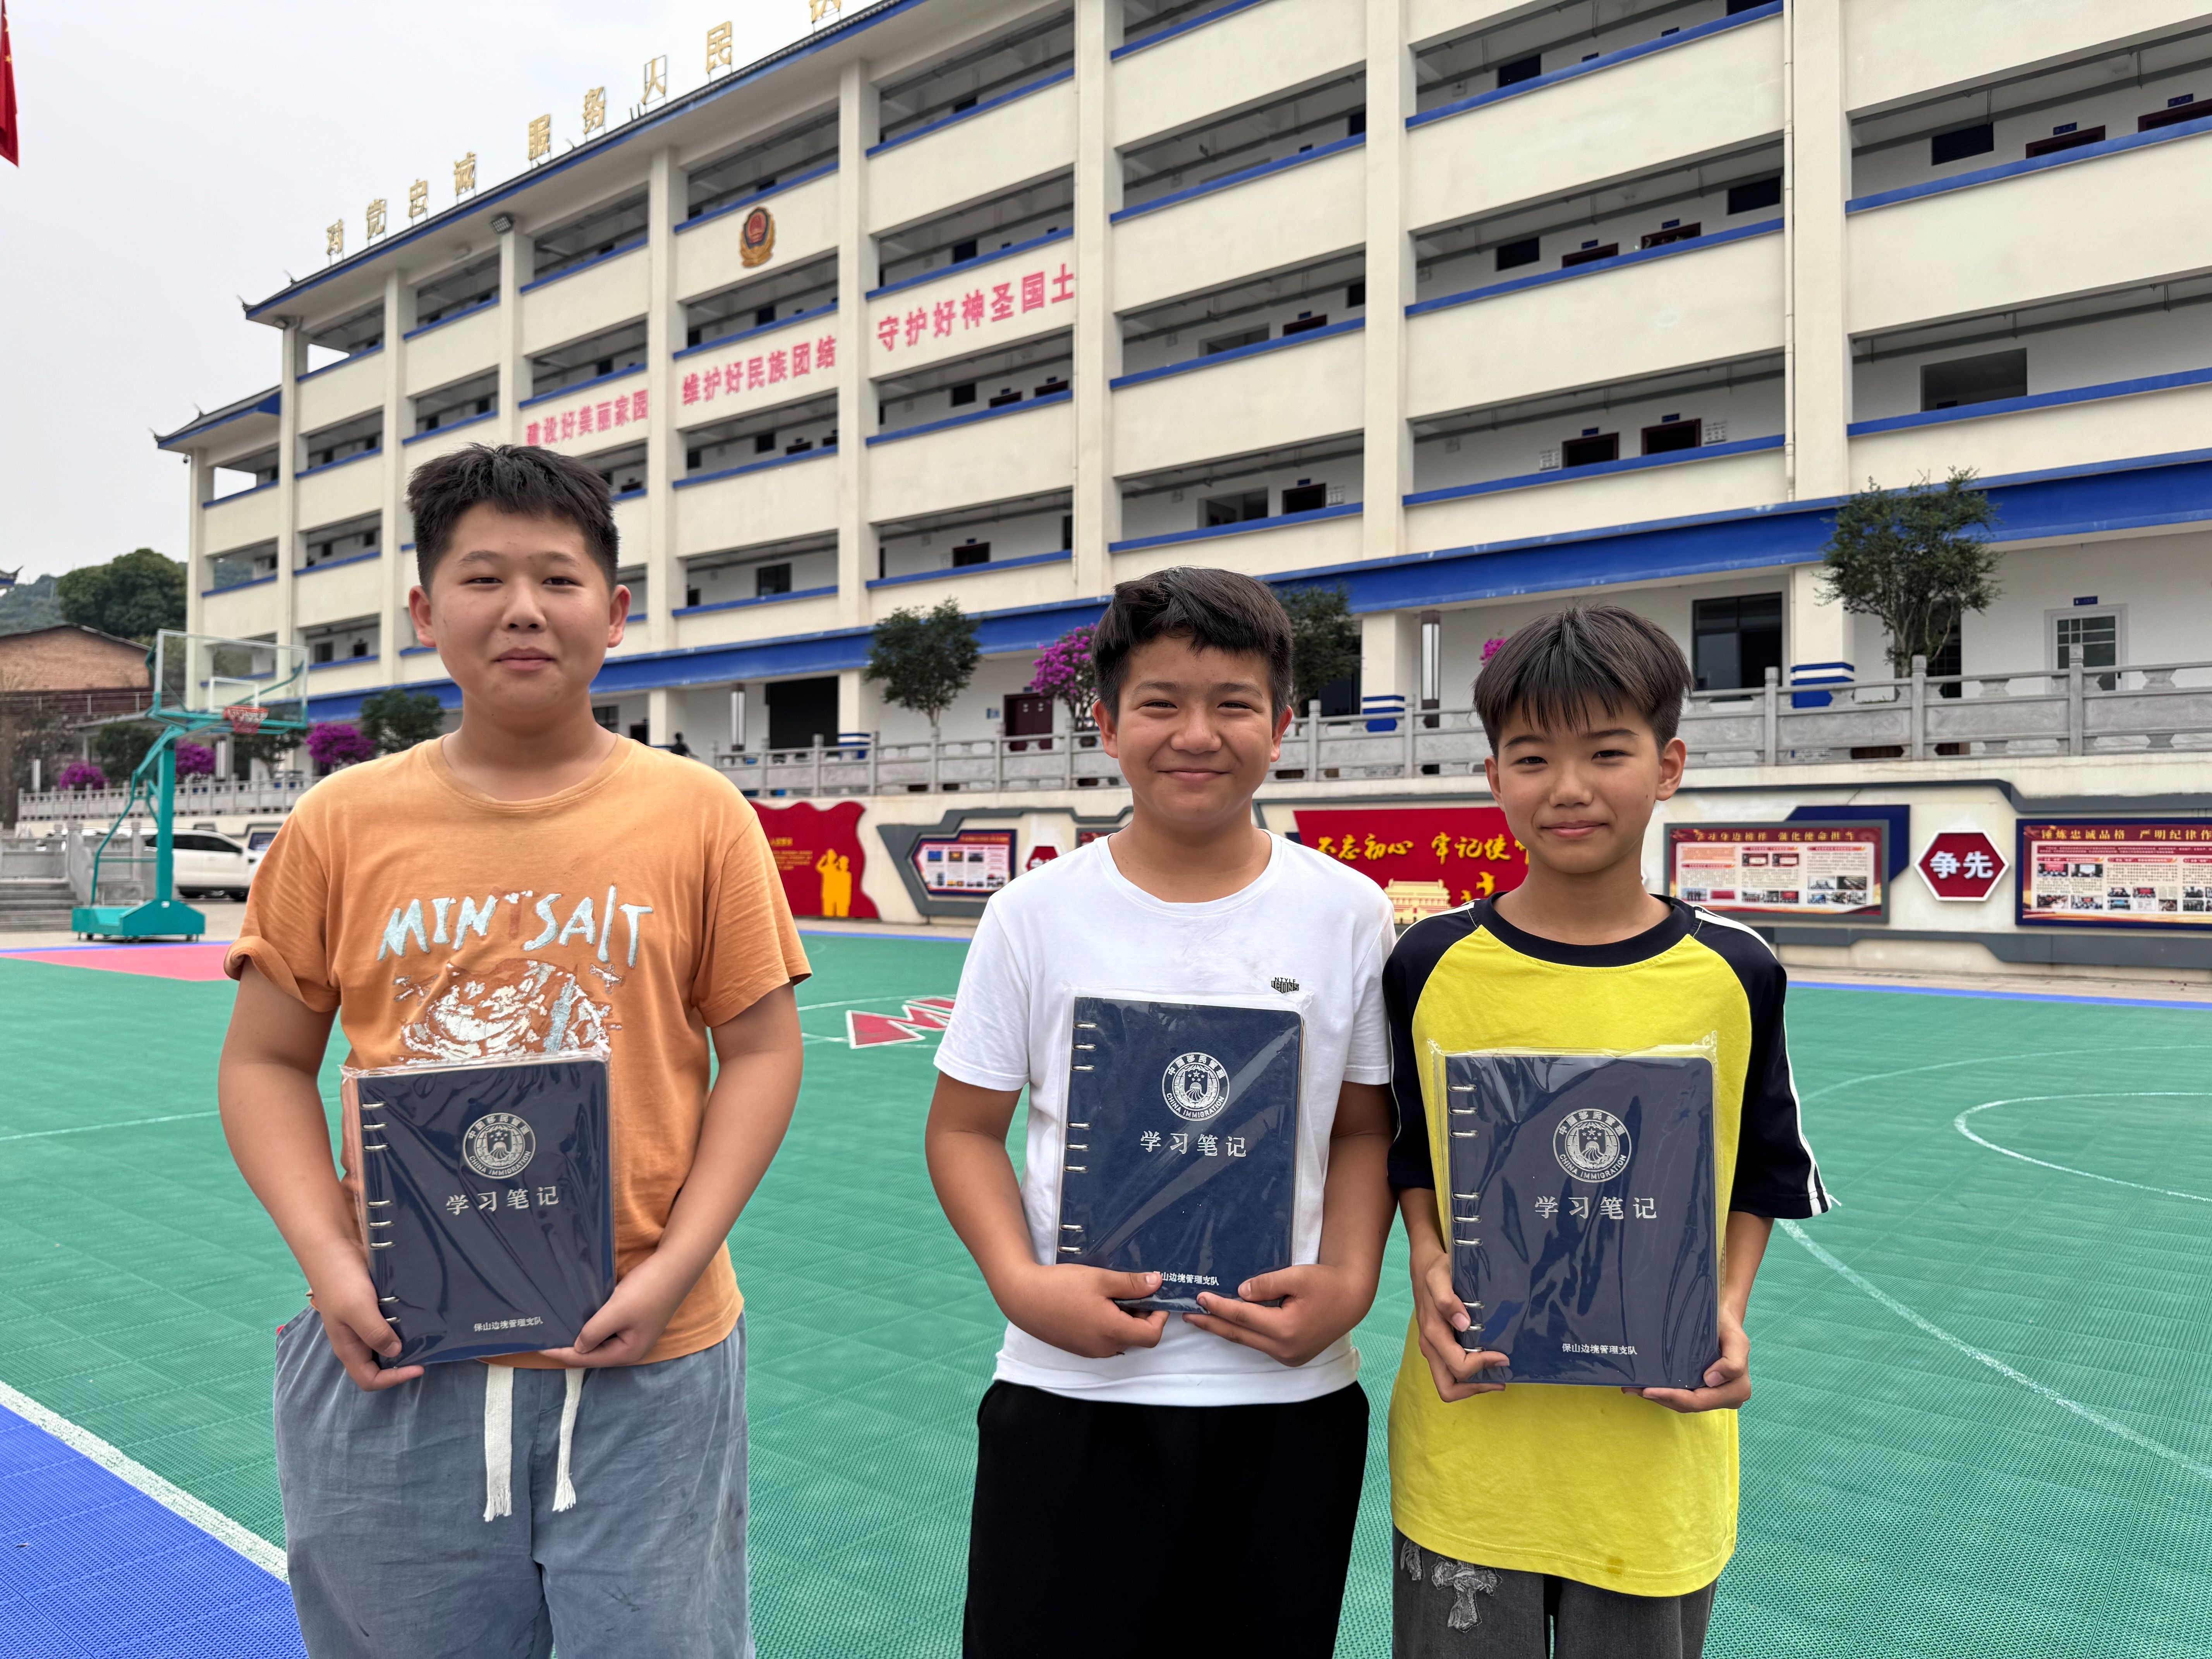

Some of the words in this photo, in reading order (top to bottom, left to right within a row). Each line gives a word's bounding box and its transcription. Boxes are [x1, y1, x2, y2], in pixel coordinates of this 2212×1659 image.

[528, 21, 732, 161] 服务人民
[877, 263, 1075, 351] 守护好神圣国土
[682, 335, 836, 406] 维护好民族团结
[527, 390, 648, 446] 建设好美丽家园
[1317, 833, 1414, 860] 不忘初心
[2041, 829, 2125, 840] 锤炼忠诚品格
[1930, 851, 1994, 880] 争先
[1271, 981, 1299, 994] ICONS
[1166, 1093, 1181, 1113] CHINA
[1183, 1096, 1224, 1118] IMMIGRATION
[1140, 1130, 1246, 1157] 学习笔记
[469, 1156, 486, 1173] CHINA
[489, 1151, 531, 1175] IMMIGRATION
[1560, 1154, 1578, 1175] CHINA
[1580, 1154, 1626, 1179] IMMIGRATION
[446, 1186, 559, 1216] 学习笔记
[1534, 1196, 1657, 1219] 学习笔记
[1153, 1271, 1219, 1286] 山边境管理支队
[474, 1316, 543, 1332] 保山边境管理支队
[1562, 1343, 1638, 1355] 保山边境管理支队
